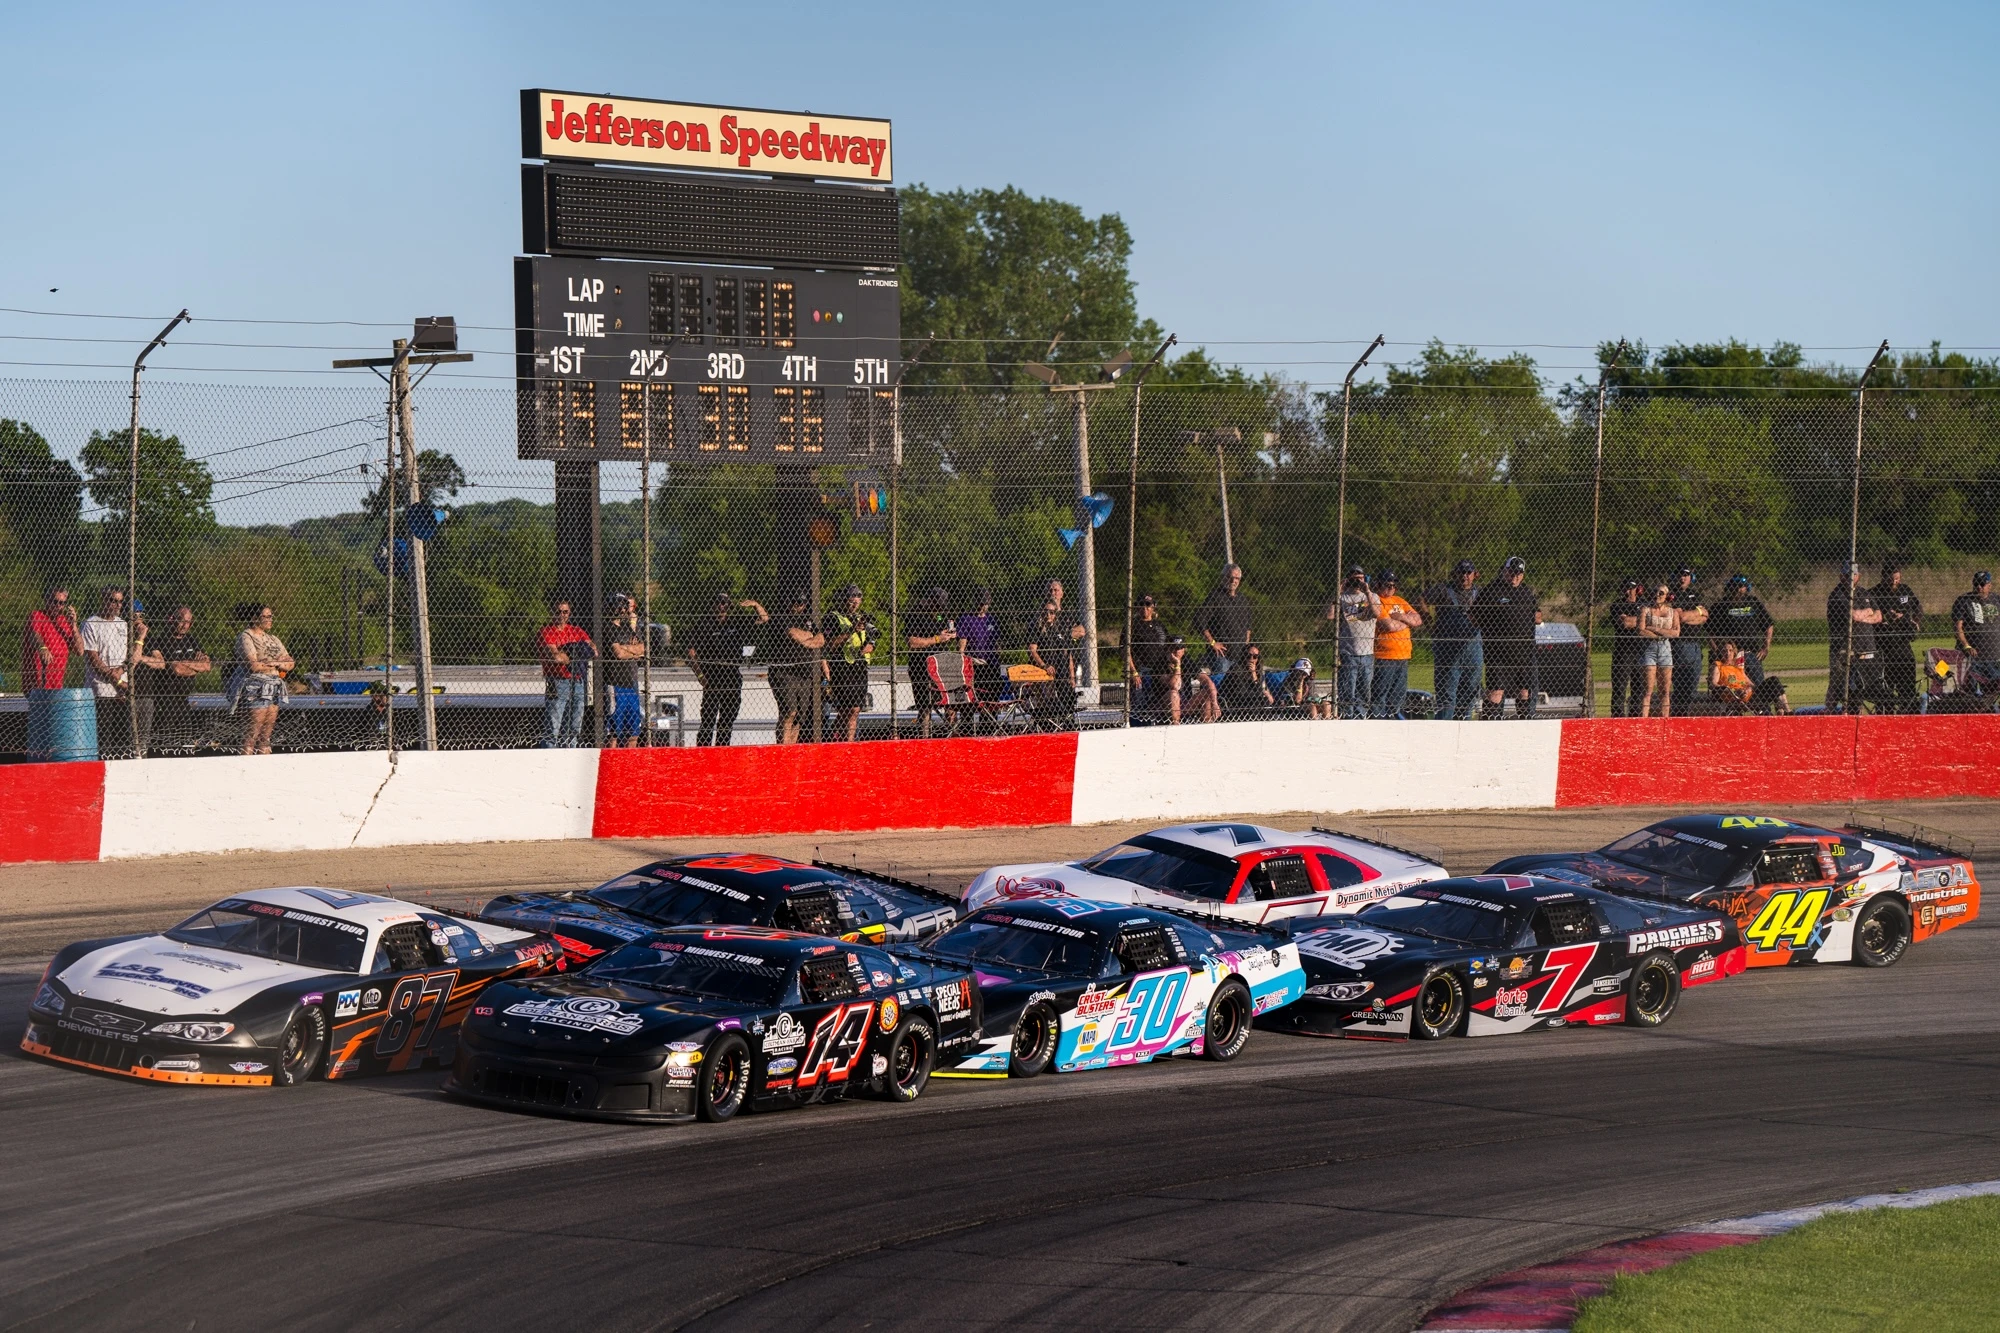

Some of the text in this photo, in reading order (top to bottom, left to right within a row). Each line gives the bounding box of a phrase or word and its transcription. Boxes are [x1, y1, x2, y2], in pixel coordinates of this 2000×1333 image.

[546, 99, 886, 176] Jefferson Speedway
[568, 277, 604, 302] LAP
[858, 279, 898, 287] DAKTRONICS
[563, 312, 605, 337] TIME
[551, 346, 585, 374] 1ST
[630, 349, 668, 376] 2ND
[707, 353, 745, 379] 3RD
[782, 355, 816, 381] 4TH
[854, 359, 888, 385] 5TH
[699, 386, 749, 451] 30
[652, 869, 683, 880] ASA
[680, 875, 750, 902] MIDWEST TOUR
[1337, 888, 1373, 905] Dynamic
[1375, 883, 1398, 898] Metal
[247, 903, 285, 916] ASA
[1439, 893, 1504, 912] MIDWEST TOUR
[283, 911, 366, 936] MIDWEST TOUR
[1012, 918, 1085, 939] MIDWEST TOUR
[1745, 886, 1834, 953] 44
[649, 942, 685, 951] ASA
[1297, 932, 1380, 955] PMI
[1629, 921, 1722, 954] PROGRESS
[683, 946, 764, 966] MIDWEST TOUR
[1692, 959, 1715, 975] REED
[1532, 941, 1600, 1016] 7
[337, 993, 360, 1009] PDC
[1077, 999, 1116, 1016] BUSTERS
[1079, 992, 1107, 1006] CRUST
[1496, 987, 1528, 1005] forte
[374, 969, 459, 1058] 87
[1105, 966, 1191, 1053] 30
[1351, 1011, 1403, 1021] GREEN SWAN
[1503, 1004, 1527, 1016] bank
[57, 1020, 139, 1043] CHEVROLET SS
[540, 1015, 592, 1029] RACING
[797, 1000, 876, 1088] 14
[1081, 1030, 1096, 1045] NAPA
